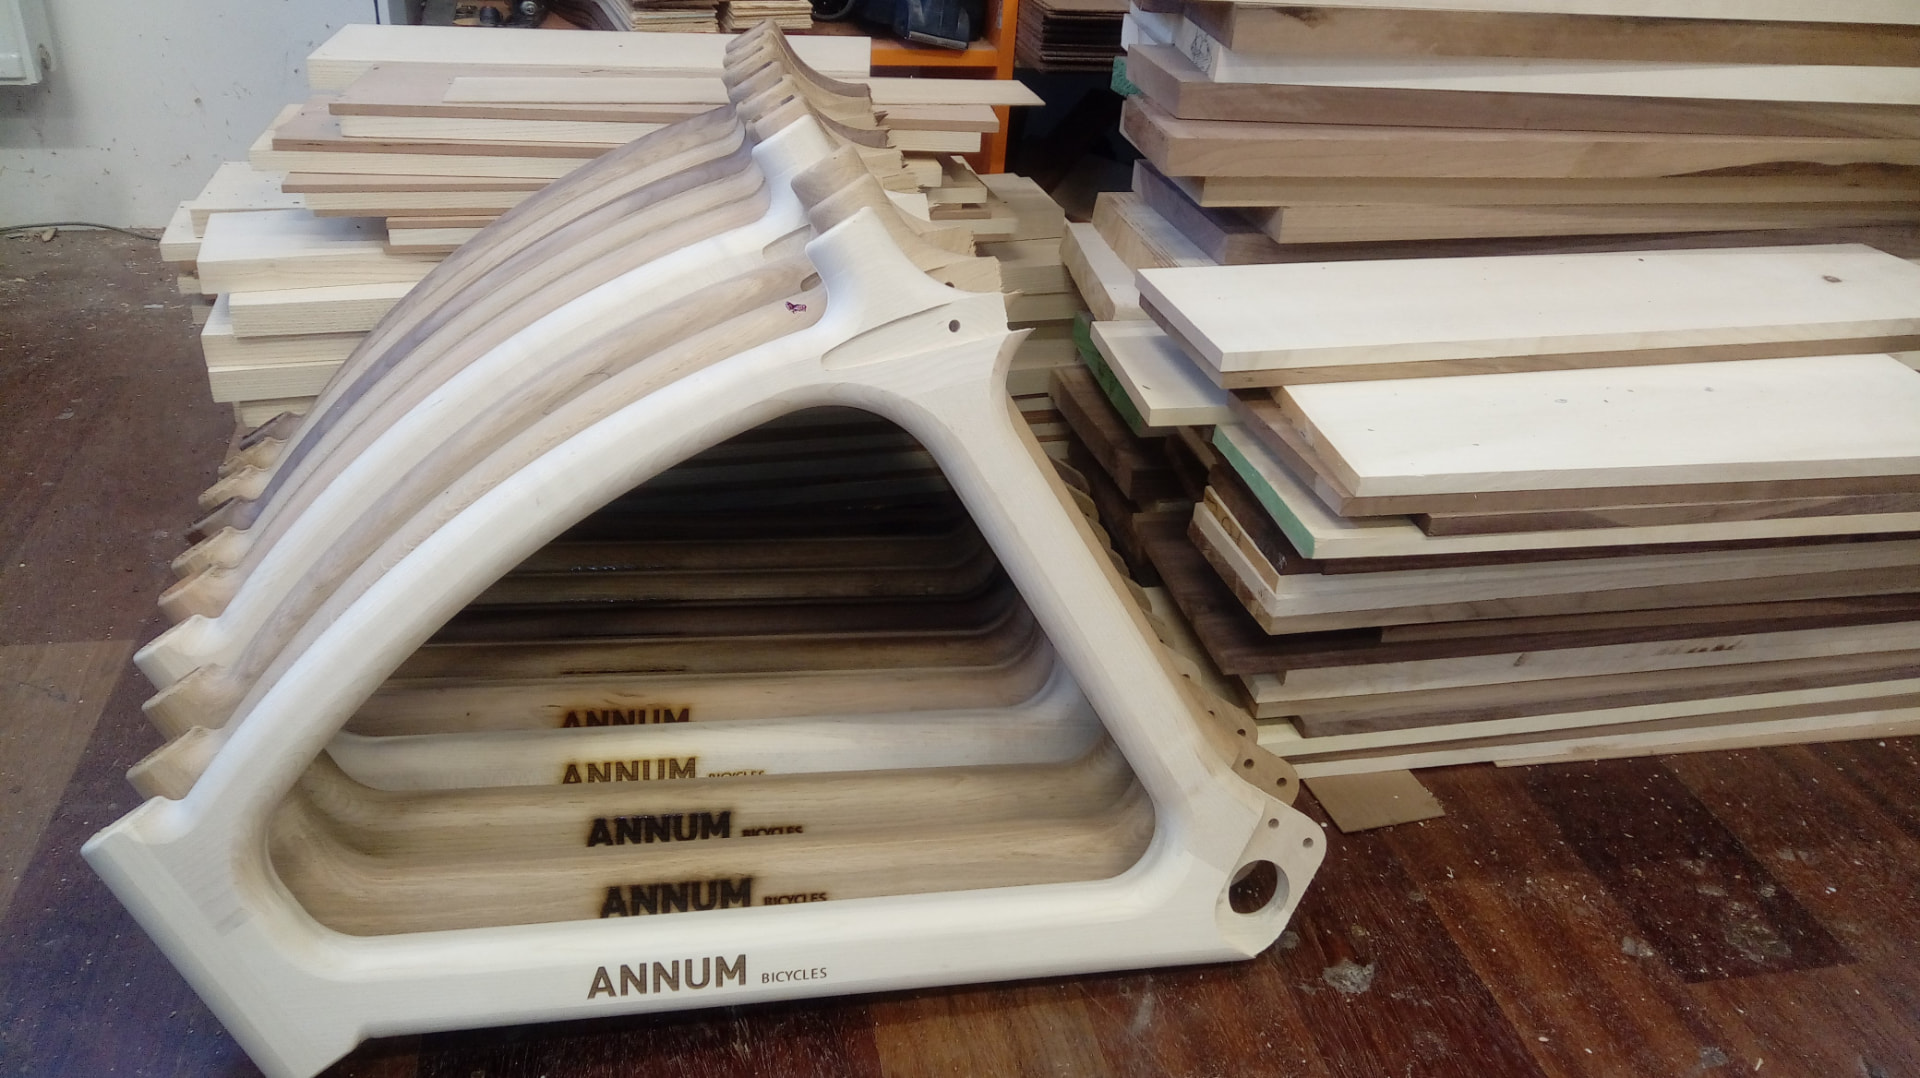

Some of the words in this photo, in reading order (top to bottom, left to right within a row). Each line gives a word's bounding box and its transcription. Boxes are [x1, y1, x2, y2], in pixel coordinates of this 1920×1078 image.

[562, 757, 697, 785] ANNUM
[587, 811, 731, 847] ANNUM
[600, 877, 753, 918] ANNUM
[763, 893, 827, 906] BICYCLES
[587, 954, 747, 1000] ANNUM
[761, 967, 828, 984] BICYCLES
